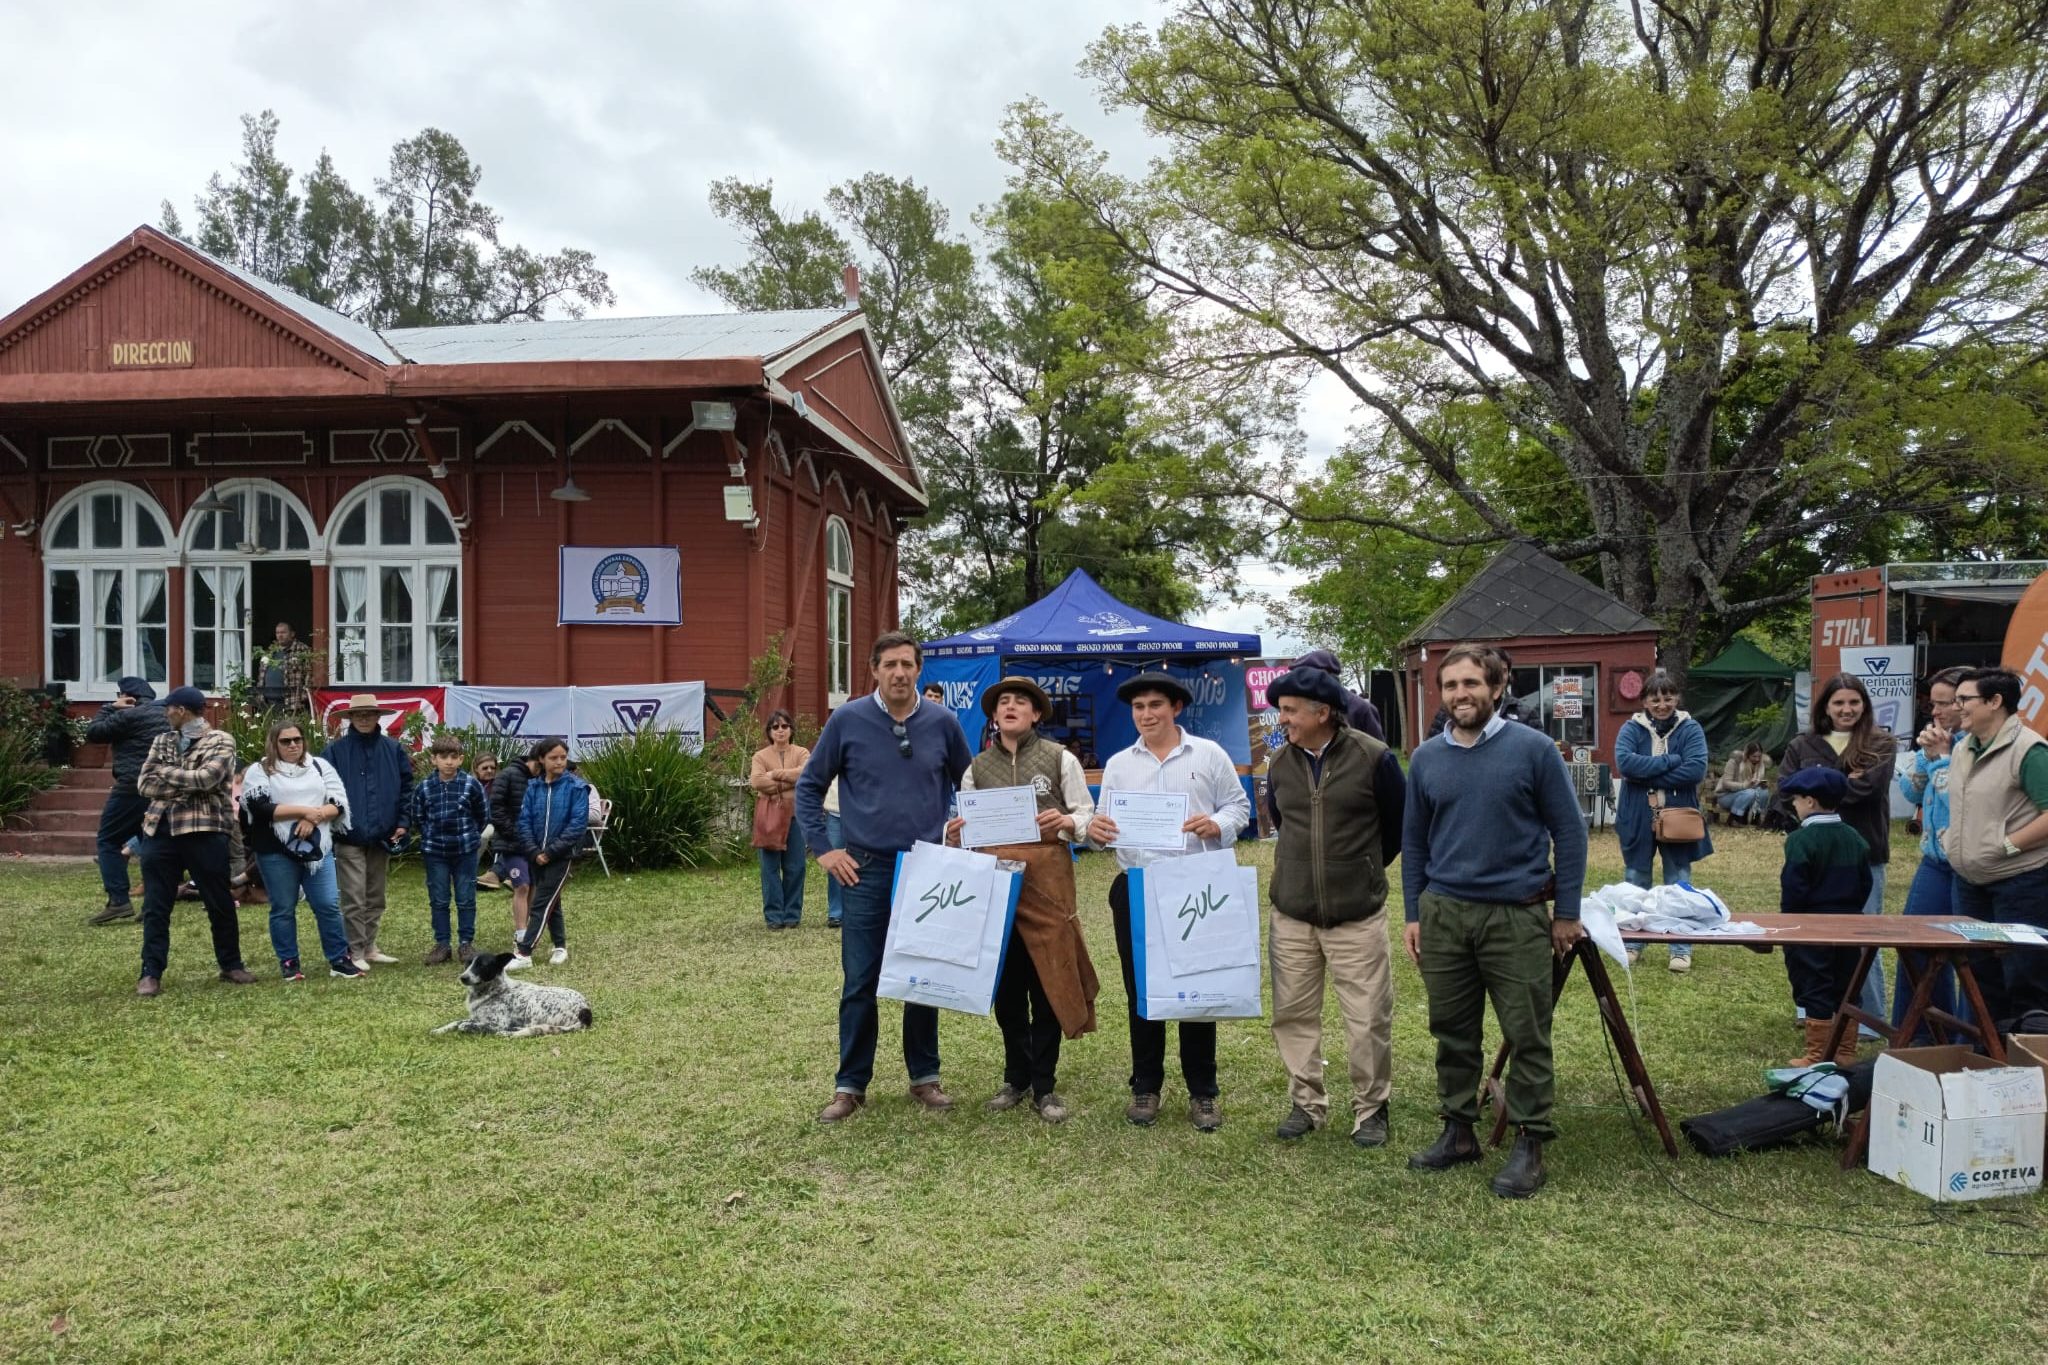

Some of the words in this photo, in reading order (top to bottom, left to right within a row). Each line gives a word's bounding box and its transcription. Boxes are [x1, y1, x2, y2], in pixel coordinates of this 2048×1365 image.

[113, 340, 192, 365] DIRECCION
[1821, 617, 1876, 646] STIHL
[915, 880, 976, 923] SUL
[1177, 883, 1230, 941] SUL
[1972, 1166, 2036, 1182] CORTEVA
